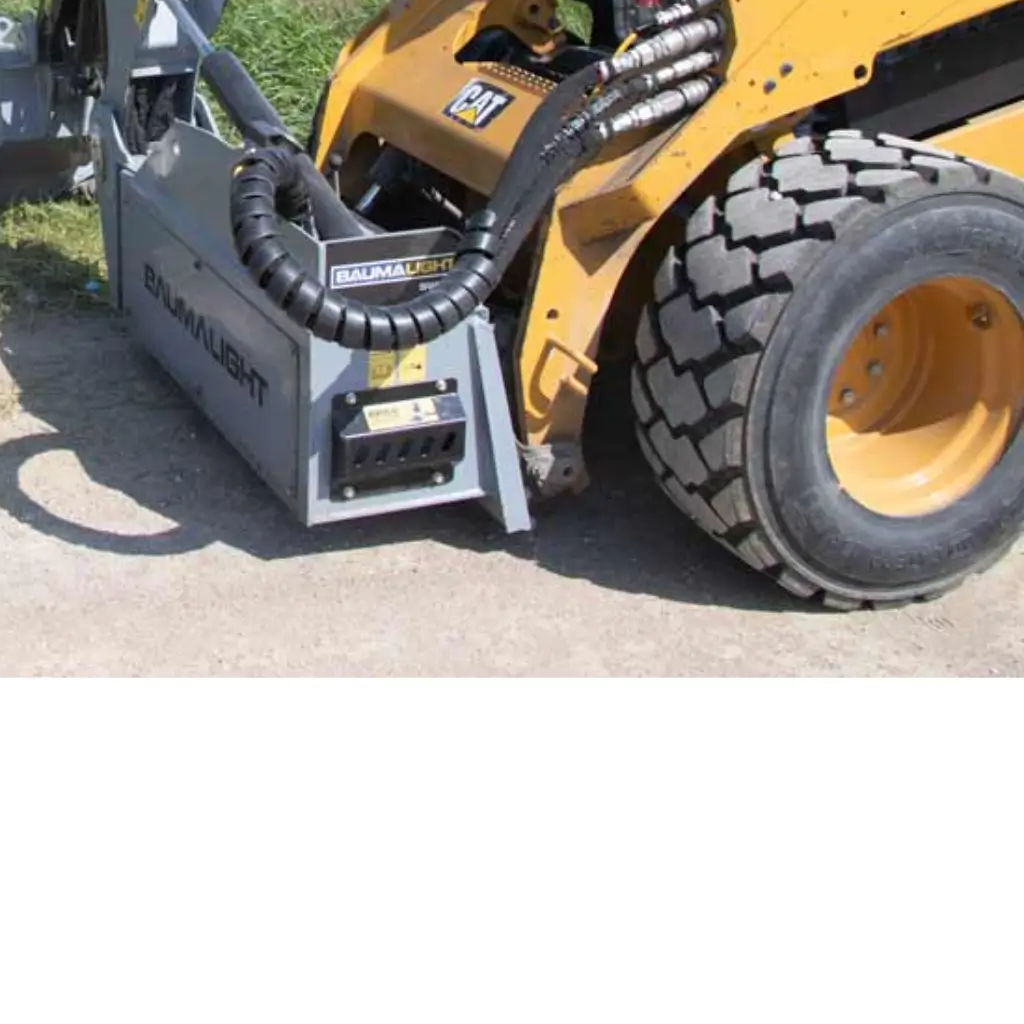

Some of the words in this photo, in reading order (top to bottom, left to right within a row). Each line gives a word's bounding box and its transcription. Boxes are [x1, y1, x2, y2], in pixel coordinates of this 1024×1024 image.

[450, 84, 508, 125] CAT
[336, 258, 454, 284] BAUMALIGHT
[144, 263, 269, 407] BAUMALIGHT
